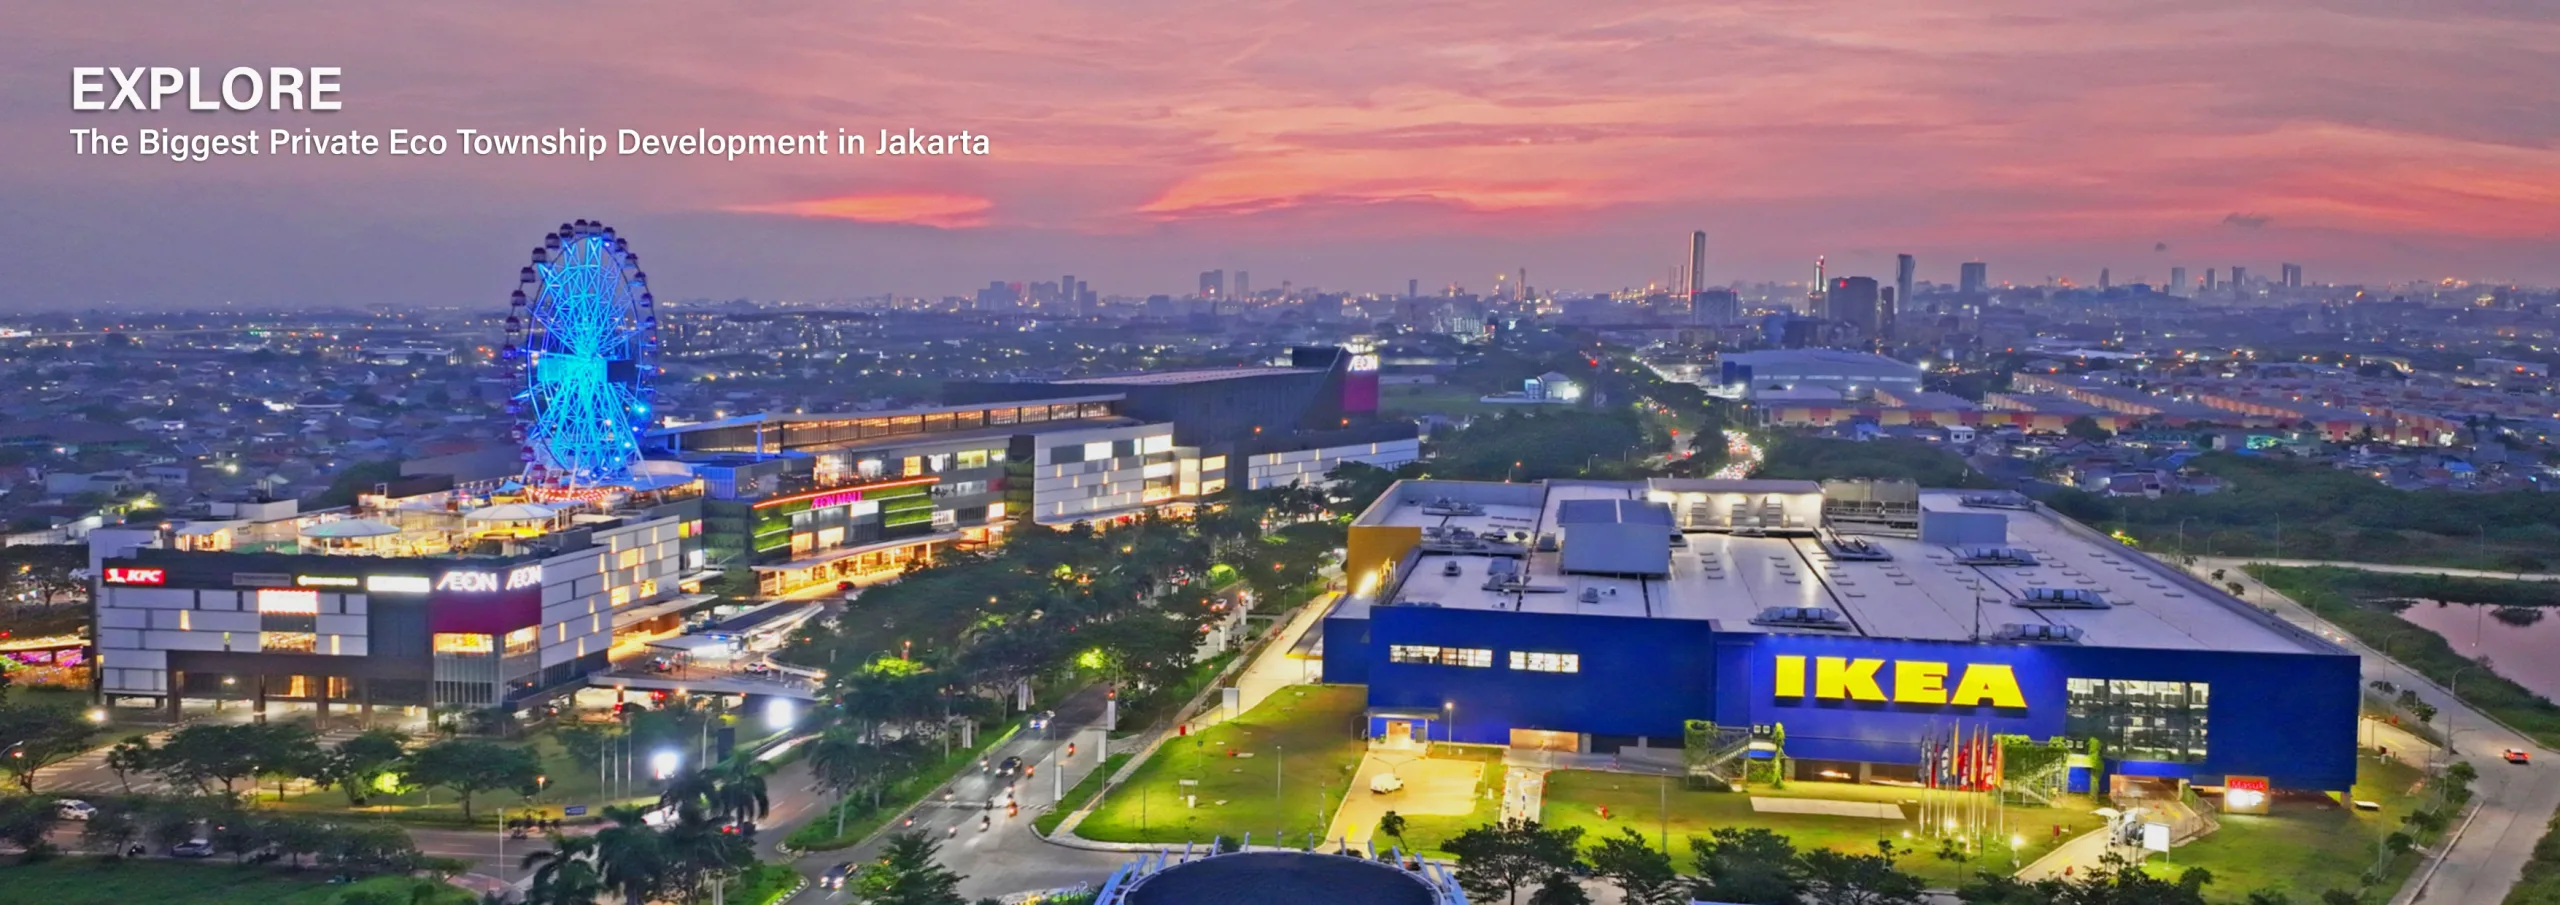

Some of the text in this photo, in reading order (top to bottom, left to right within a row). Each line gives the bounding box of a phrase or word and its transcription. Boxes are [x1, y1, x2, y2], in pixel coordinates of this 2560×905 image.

[126, 569, 163, 582] KFC
[1774, 655, 2028, 708] IKEA
[2231, 780, 2266, 791] Masuk
